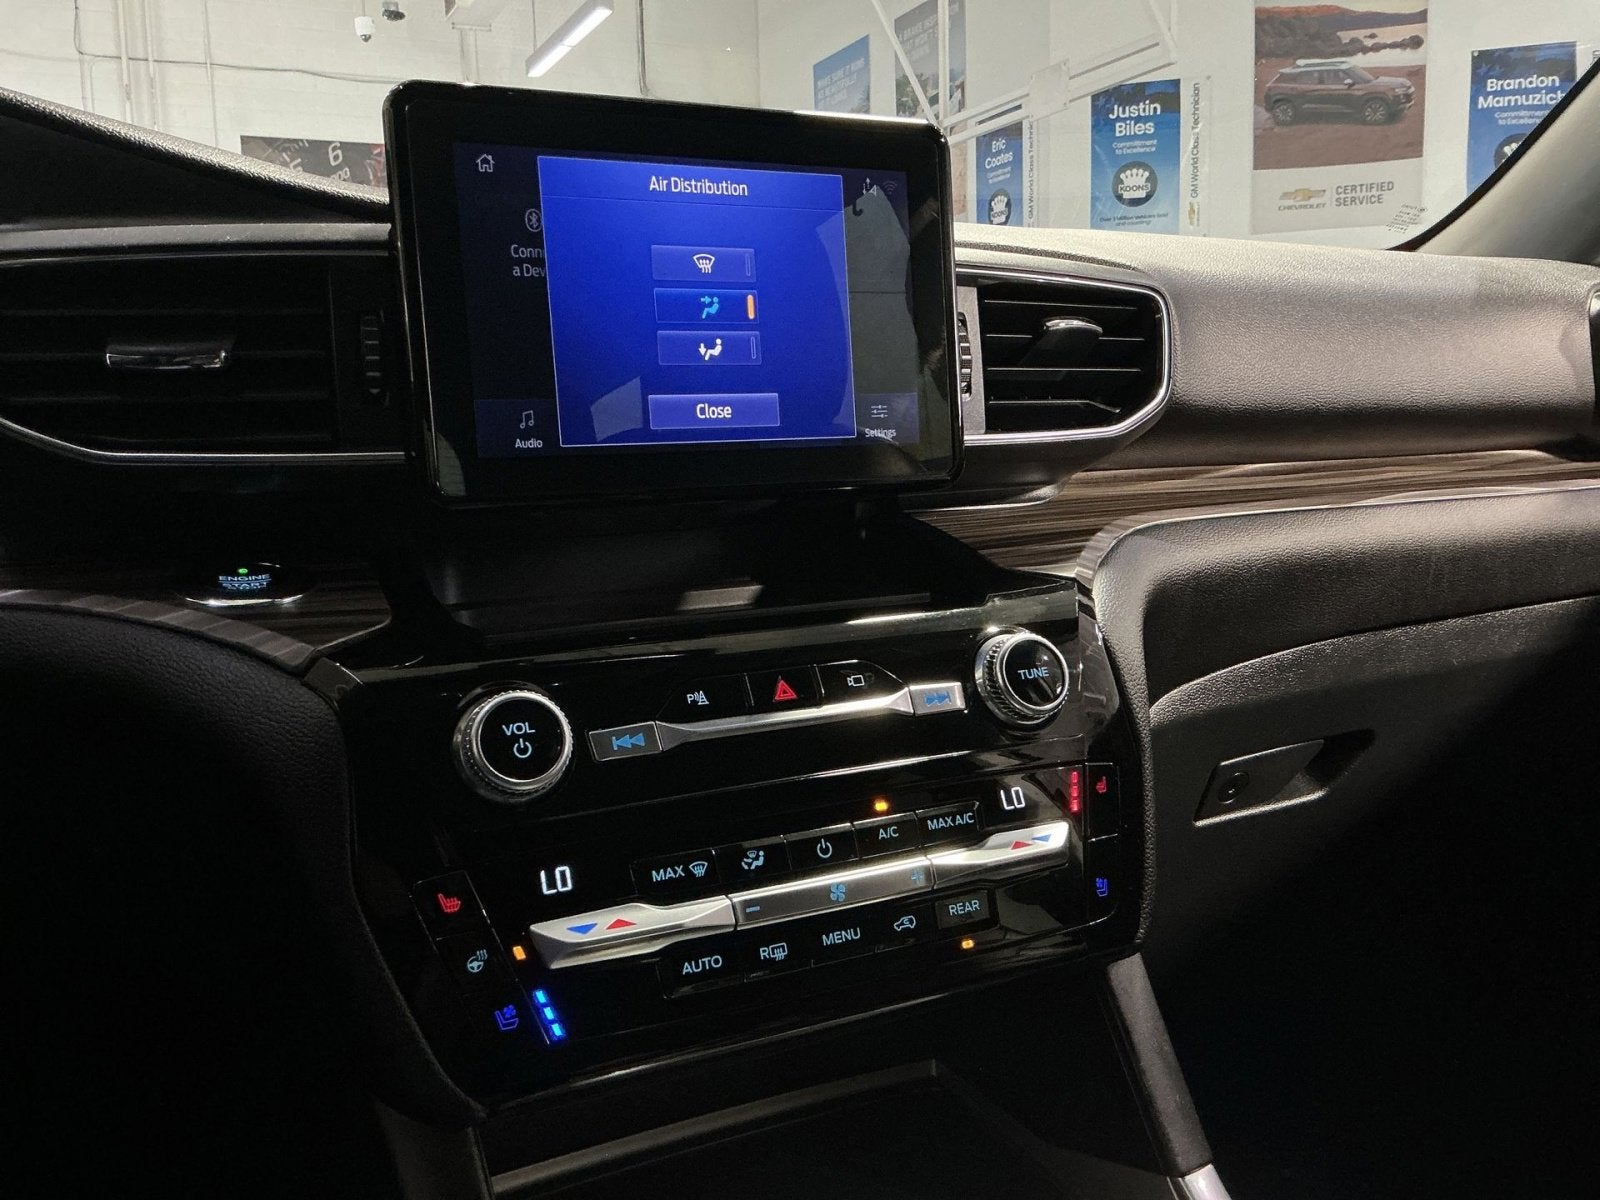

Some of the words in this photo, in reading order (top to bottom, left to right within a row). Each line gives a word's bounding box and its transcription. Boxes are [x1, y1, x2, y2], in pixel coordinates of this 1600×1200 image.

[1487, 75, 1559, 91] Brandon
[1108, 100, 1161, 119] Justin
[1191, 83, 1200, 130] Technician
[1115, 121, 1155, 137] Biles
[991, 138, 1006, 152] Eric
[328, 142, 343, 166] 6
[984, 152, 1014, 169] Coates
[1191, 157, 1199, 182] World
[649, 175, 668, 191] Air
[670, 177, 748, 196] Distribution
[1119, 183, 1151, 193] KOONS
[1190, 184, 1199, 198] GM
[1335, 181, 1395, 196] CERTIFIED
[1278, 203, 1327, 211] CHEVROLET
[1335, 194, 1384, 207] SERVICE
[510, 244, 545, 258] Conn
[512, 266, 521, 277] a
[523, 263, 545, 277] Dev
[696, 403, 732, 419] Close
[864, 427, 897, 439] Settings
[515, 438, 543, 448] Audio
[1017, 666, 1050, 682] TUNE
[502, 722, 535, 737] VOL
[1000, 786, 1026, 811] LO
[927, 816, 954, 831] MAX
[955, 812, 975, 826] A/C
[878, 825, 900, 840] A/C
[539, 865, 573, 895] LO
[651, 865, 686, 883] MAX
[948, 900, 980, 917] REAR
[822, 927, 862, 946] MENU
[682, 955, 723, 975] AUTO
